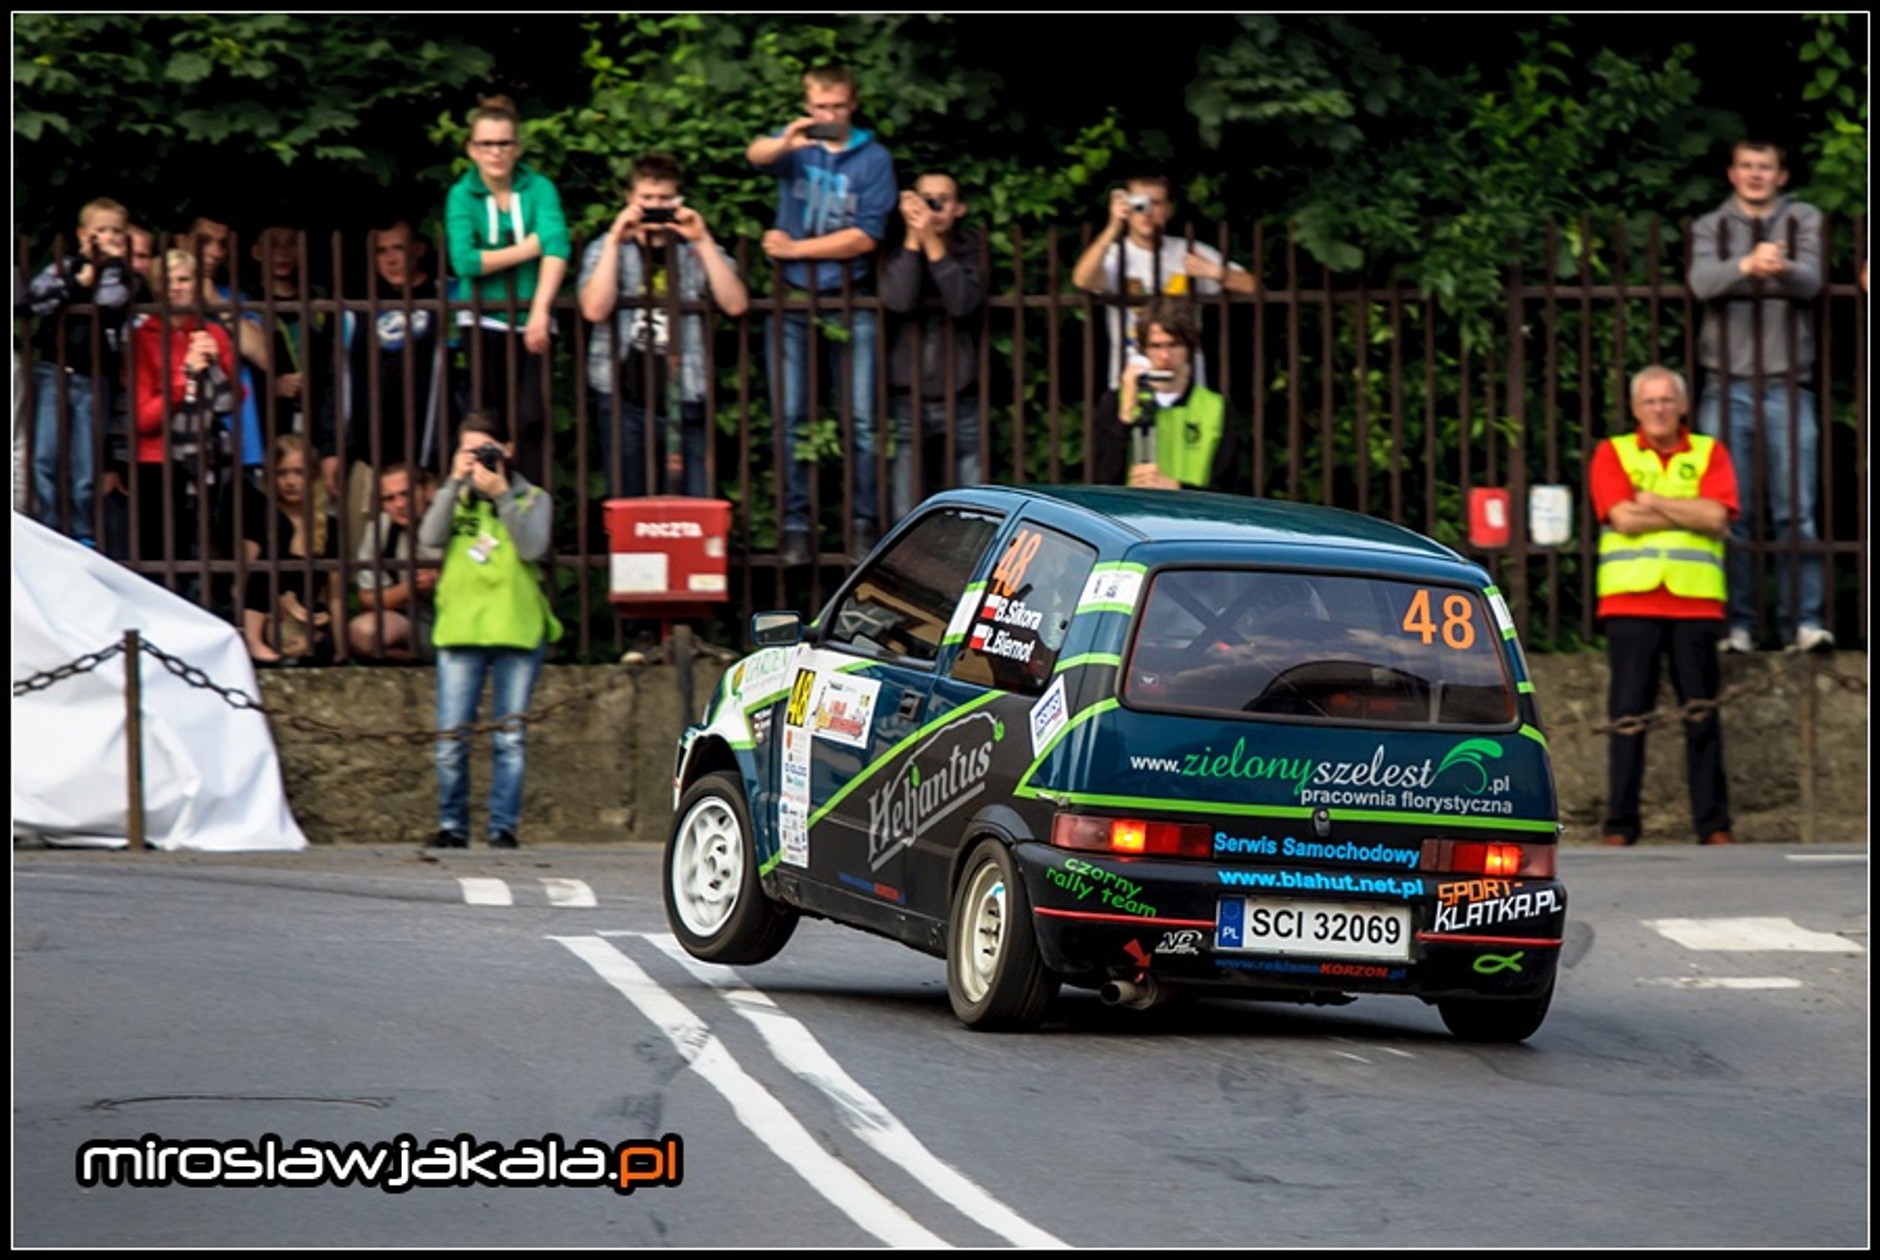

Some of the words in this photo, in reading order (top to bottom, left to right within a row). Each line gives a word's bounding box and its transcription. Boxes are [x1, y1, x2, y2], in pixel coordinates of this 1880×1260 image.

[634, 521, 704, 538] POCZTA
[993, 529, 1042, 597] 48
[1403, 588, 1476, 650] 48
[788, 669, 815, 727] 48
[1301, 788, 1397, 806] pracownia
[1401, 791, 1513, 815] florystyczna
[1214, 831, 1278, 855] Serwis
[1282, 837, 1420, 869] Samochodowy
[1046, 868, 1095, 900] rally
[1101, 887, 1157, 919] team
[1064, 857, 1142, 900] czorny
[1218, 870, 1425, 898] www.blahut.net.pl
[1437, 877, 1524, 907] SPORT-
[1251, 908, 1304, 939] SCI
[1313, 912, 1401, 946] 32069
[1434, 889, 1563, 933] KLATKA.PL
[1222, 925, 1240, 940] PL
